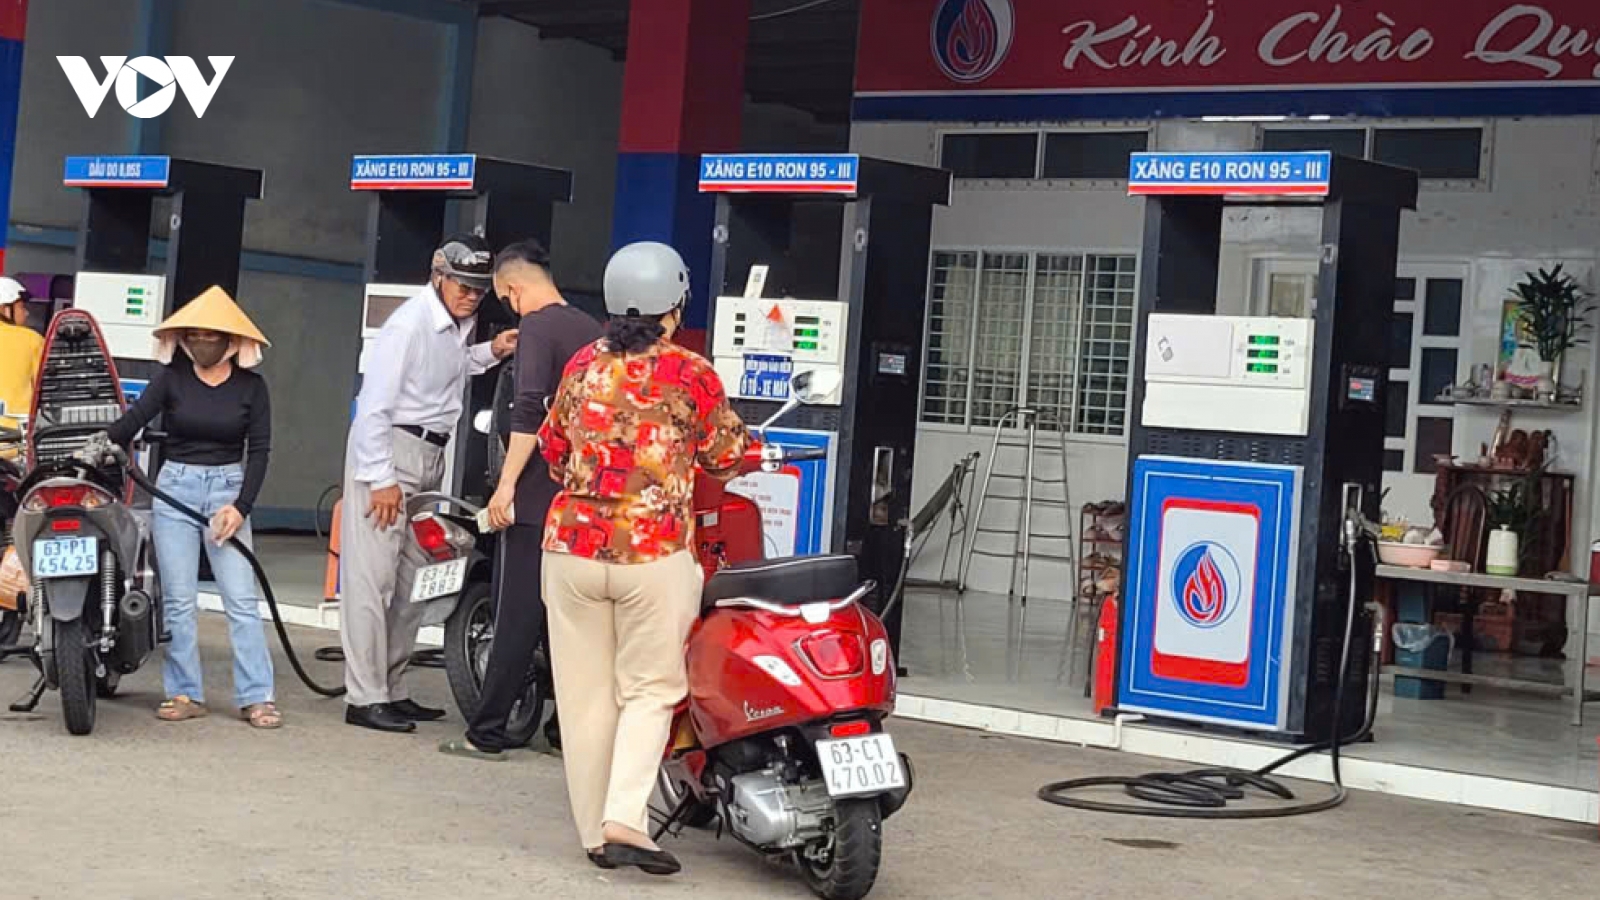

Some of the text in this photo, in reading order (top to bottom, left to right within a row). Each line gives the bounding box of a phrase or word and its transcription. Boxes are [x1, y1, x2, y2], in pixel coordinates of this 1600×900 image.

[1061, 3, 1600, 78] Kính Chào Qu
[356, 160, 387, 177] XĂNG
[388, 162, 409, 177] E10
[410, 162, 435, 177] RON
[437, 162, 450, 177] 95
[705, 159, 744, 178] XĂNG
[747, 162, 772, 179] E10
[775, 162, 807, 179] RON
[809, 162, 827, 179] 95
[838, 162, 851, 179] III
[1135, 158, 1185, 179] XĂNG
[1189, 162, 1221, 179] E10
[1225, 161, 1265, 179] RON
[1269, 161, 1290, 179] 95
[1305, 161, 1322, 179] III
[830, 738, 885, 765] 63-C1
[831, 761, 899, 790] 470.02
